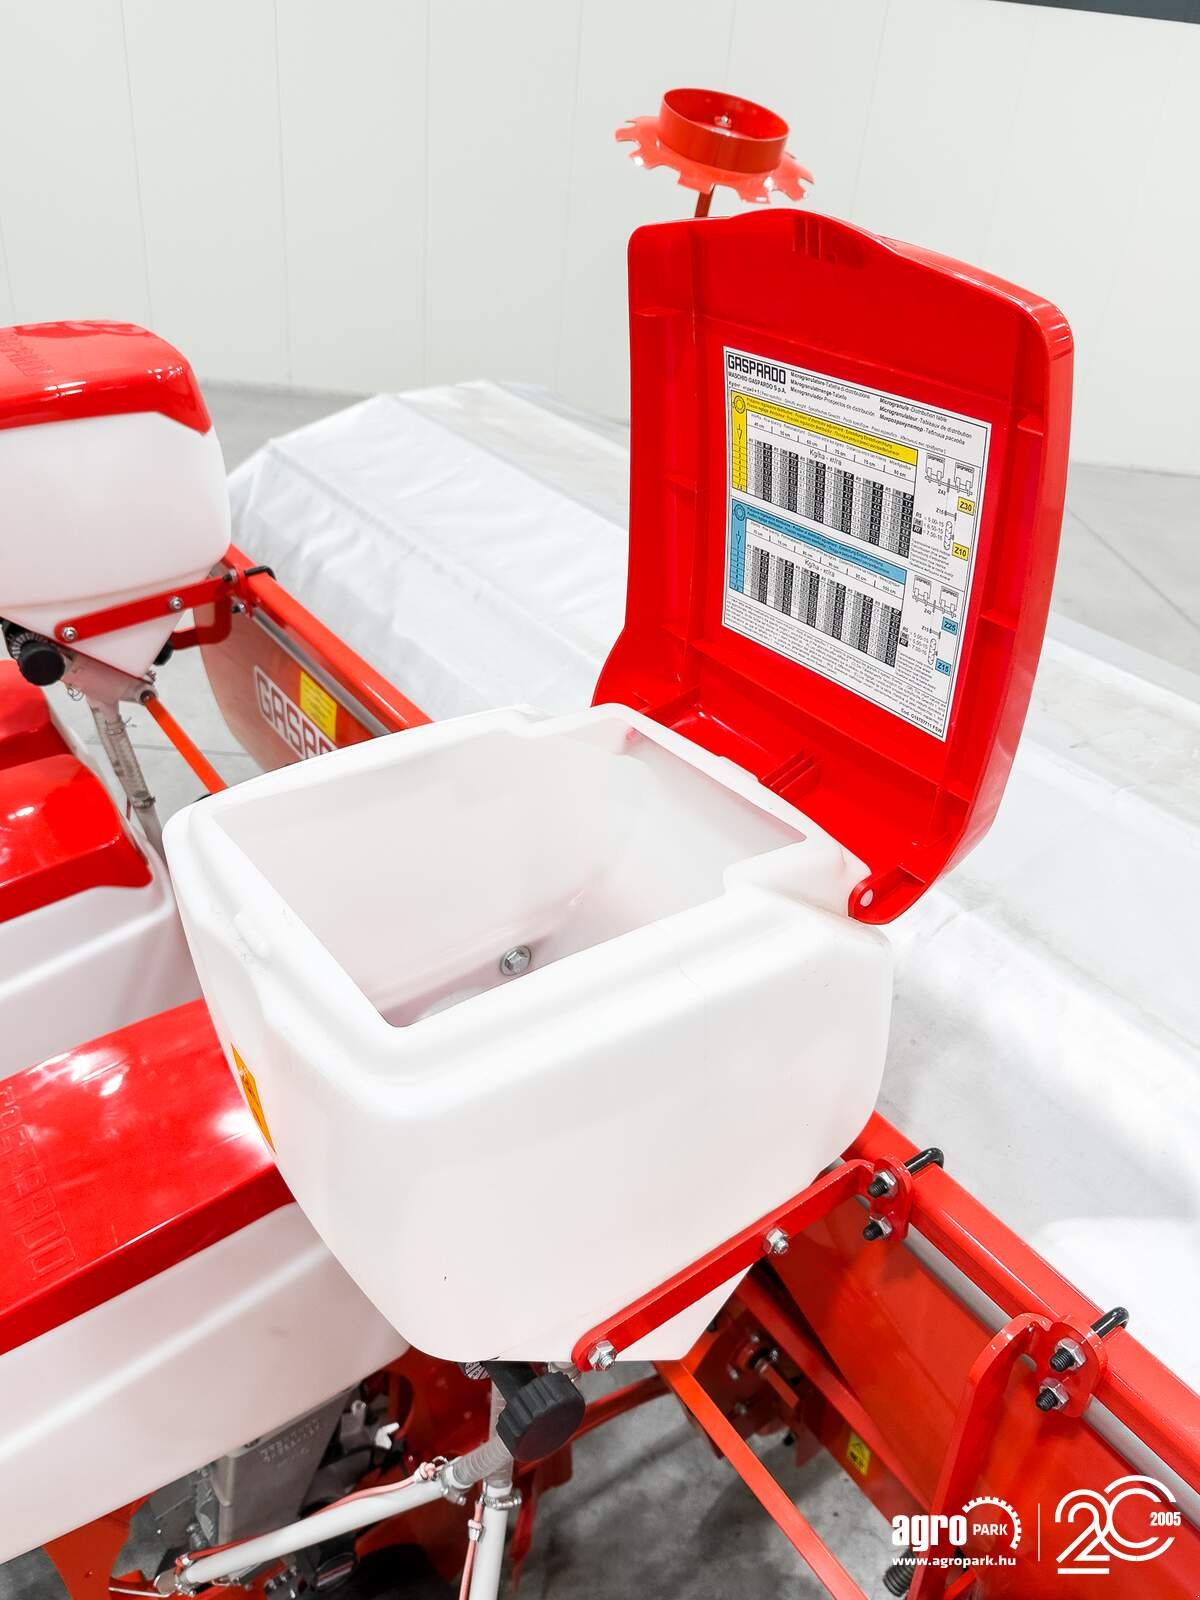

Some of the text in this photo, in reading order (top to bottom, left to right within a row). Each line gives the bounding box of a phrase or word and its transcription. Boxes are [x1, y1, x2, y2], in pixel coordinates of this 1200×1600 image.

[728, 354, 786, 385] GASPARDO
[748, 377, 773, 390] GASPARDO
[959, 501, 972, 512] Z30
[954, 546, 966, 557] Z10
[944, 620, 956, 632] Z25
[937, 663, 949, 674] Z15
